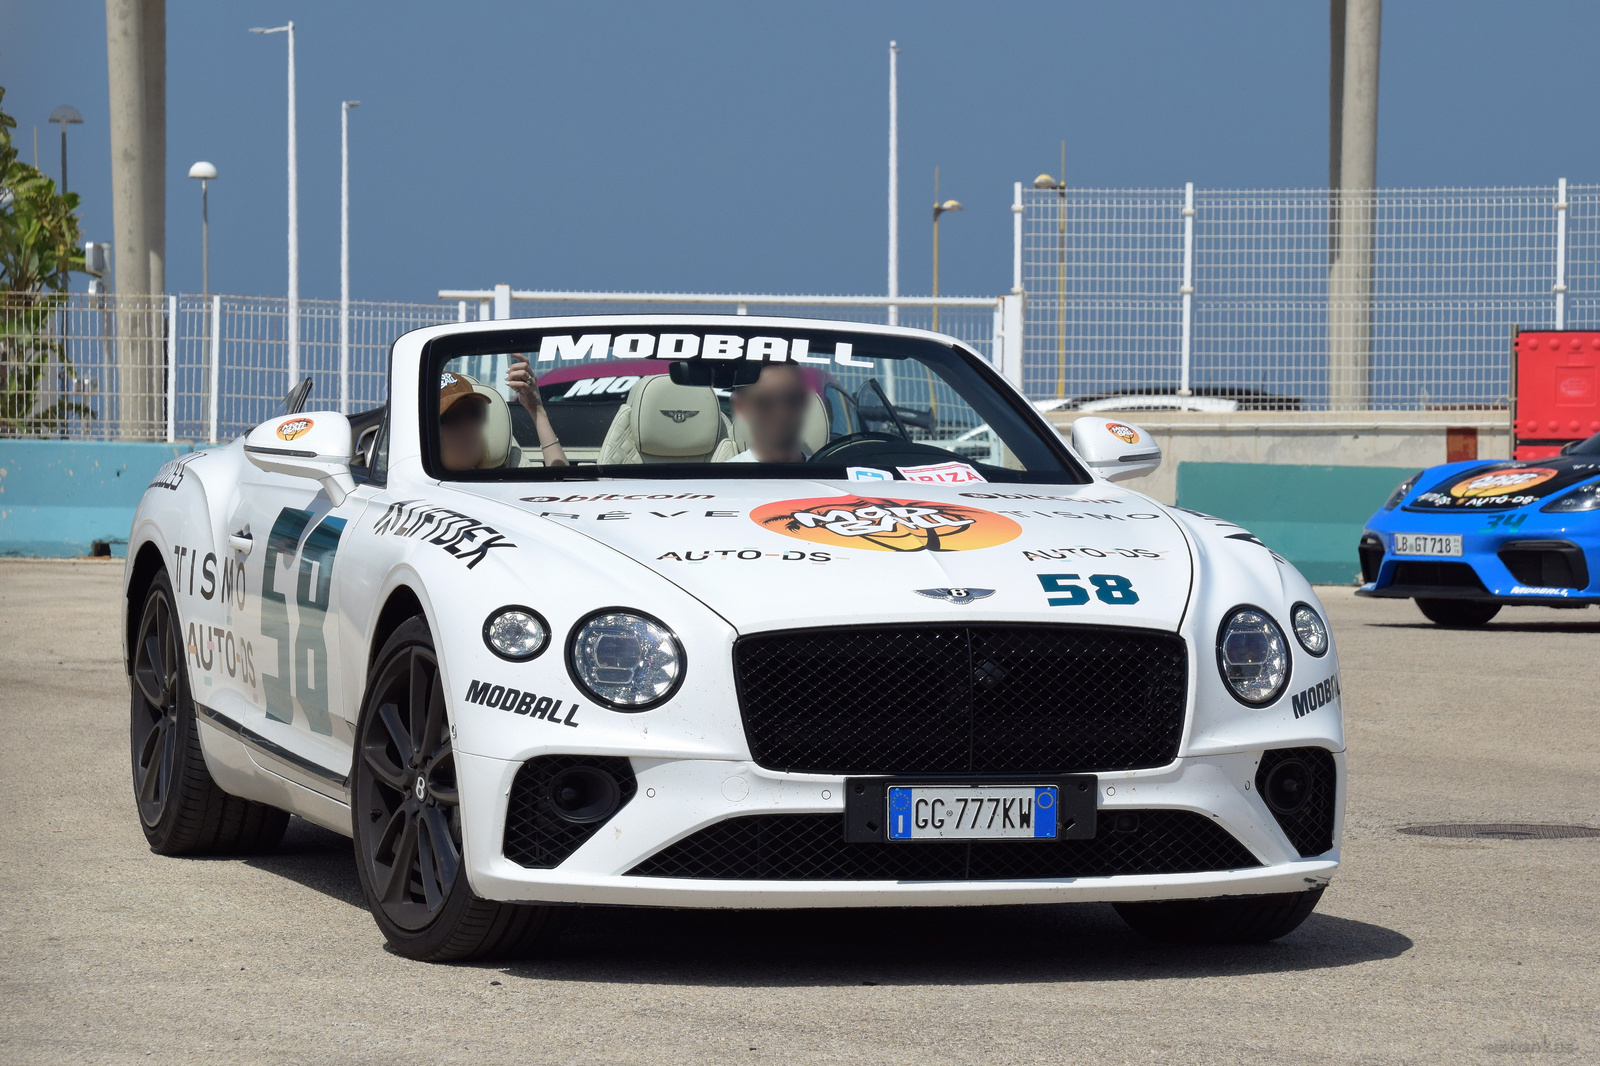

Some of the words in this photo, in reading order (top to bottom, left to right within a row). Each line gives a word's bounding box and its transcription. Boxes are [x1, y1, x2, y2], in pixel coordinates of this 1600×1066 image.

[537, 333, 875, 368] MODBALL
[559, 493, 716, 502] bitcoin
[992, 493, 1125, 504] bitcoin
[793, 505, 940, 529] MOD
[826, 514, 976, 536] BALL
[1477, 514, 1528, 533] 34
[656, 549, 832, 562] AUTO-DS
[1022, 547, 1161, 562] AUTO-DS
[1036, 573, 1140, 607] 58
[260, 506, 348, 737] 58
[464, 679, 580, 728] MODBALL
[914, 798, 946, 830] GG
[954, 797, 1033, 830] 777KW
